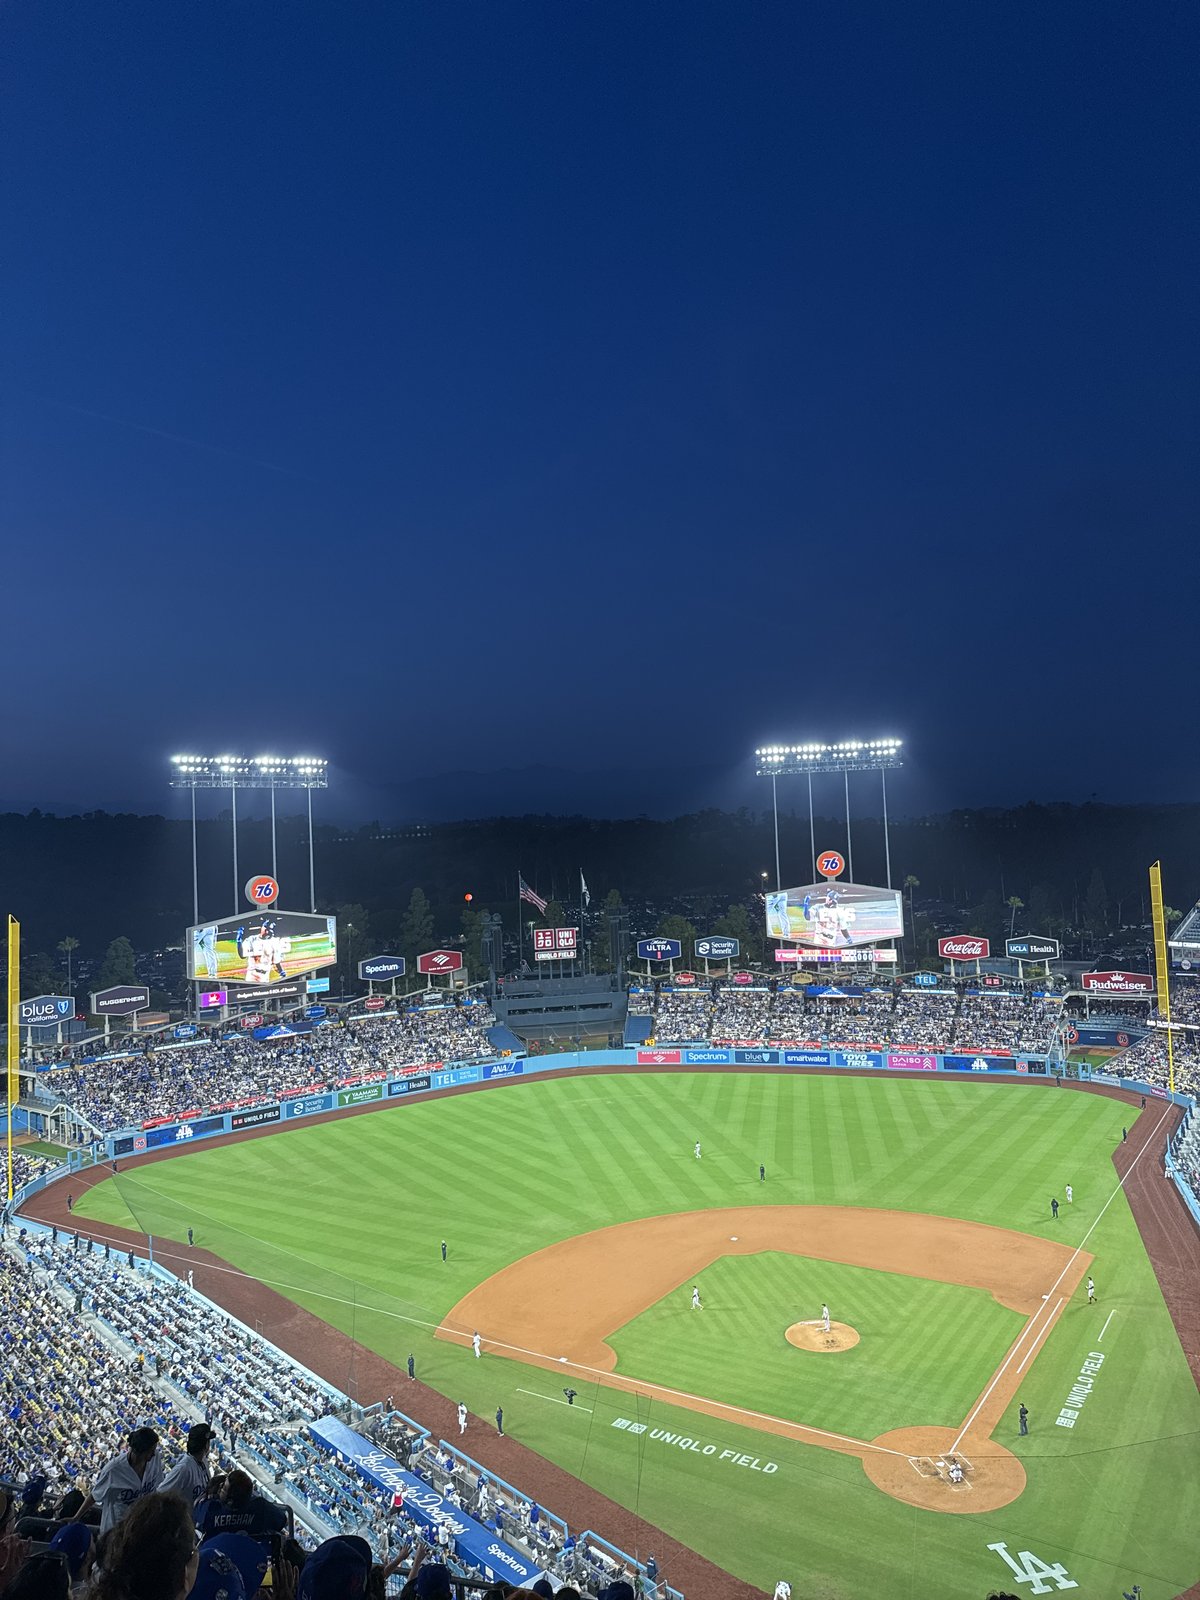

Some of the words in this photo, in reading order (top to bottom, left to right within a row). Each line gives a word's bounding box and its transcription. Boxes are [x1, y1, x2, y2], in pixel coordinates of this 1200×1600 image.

[821, 856, 840, 871] 76
[256, 882, 274, 898] 76
[711, 941, 735, 950] Security
[1030, 945, 1055, 953] Health
[537, 952, 558, 960] UNIQLO
[365, 963, 399, 975] Spectrum
[1089, 979, 1147, 990] Budweiser
[99, 995, 145, 1006] GUGGENHEIM
[22, 1003, 55, 1017] blue
[27, 1014, 59, 1023] california
[688, 1052, 724, 1061] Spectrum
[744, 1052, 762, 1060] blue
[786, 1055, 828, 1063] smartwater
[892, 1056, 921, 1064] DAISO
[490, 1064, 508, 1075] ANA
[436, 1074, 457, 1086] TEL
[392, 1083, 407, 1092] UCLA
[409, 1080, 428, 1090] Health
[304, 1099, 324, 1107] Security
[304, 1104, 322, 1112] Benefit
[243, 1114, 263, 1124] UNIQLO
[263, 1110, 279, 1119] FIELD
[135, 1139, 145, 1147] 76
[1064, 1375, 1095, 1409] UNIQLO
[1080, 1351, 1105, 1377] FIELD
[649, 1428, 717, 1455] UNIQLO
[718, 1449, 779, 1474] FIELD
[411, 1493, 470, 1536] Dodgers
[487, 1543, 525, 1576] Spectrum
[986, 1541, 1080, 1595] LA
